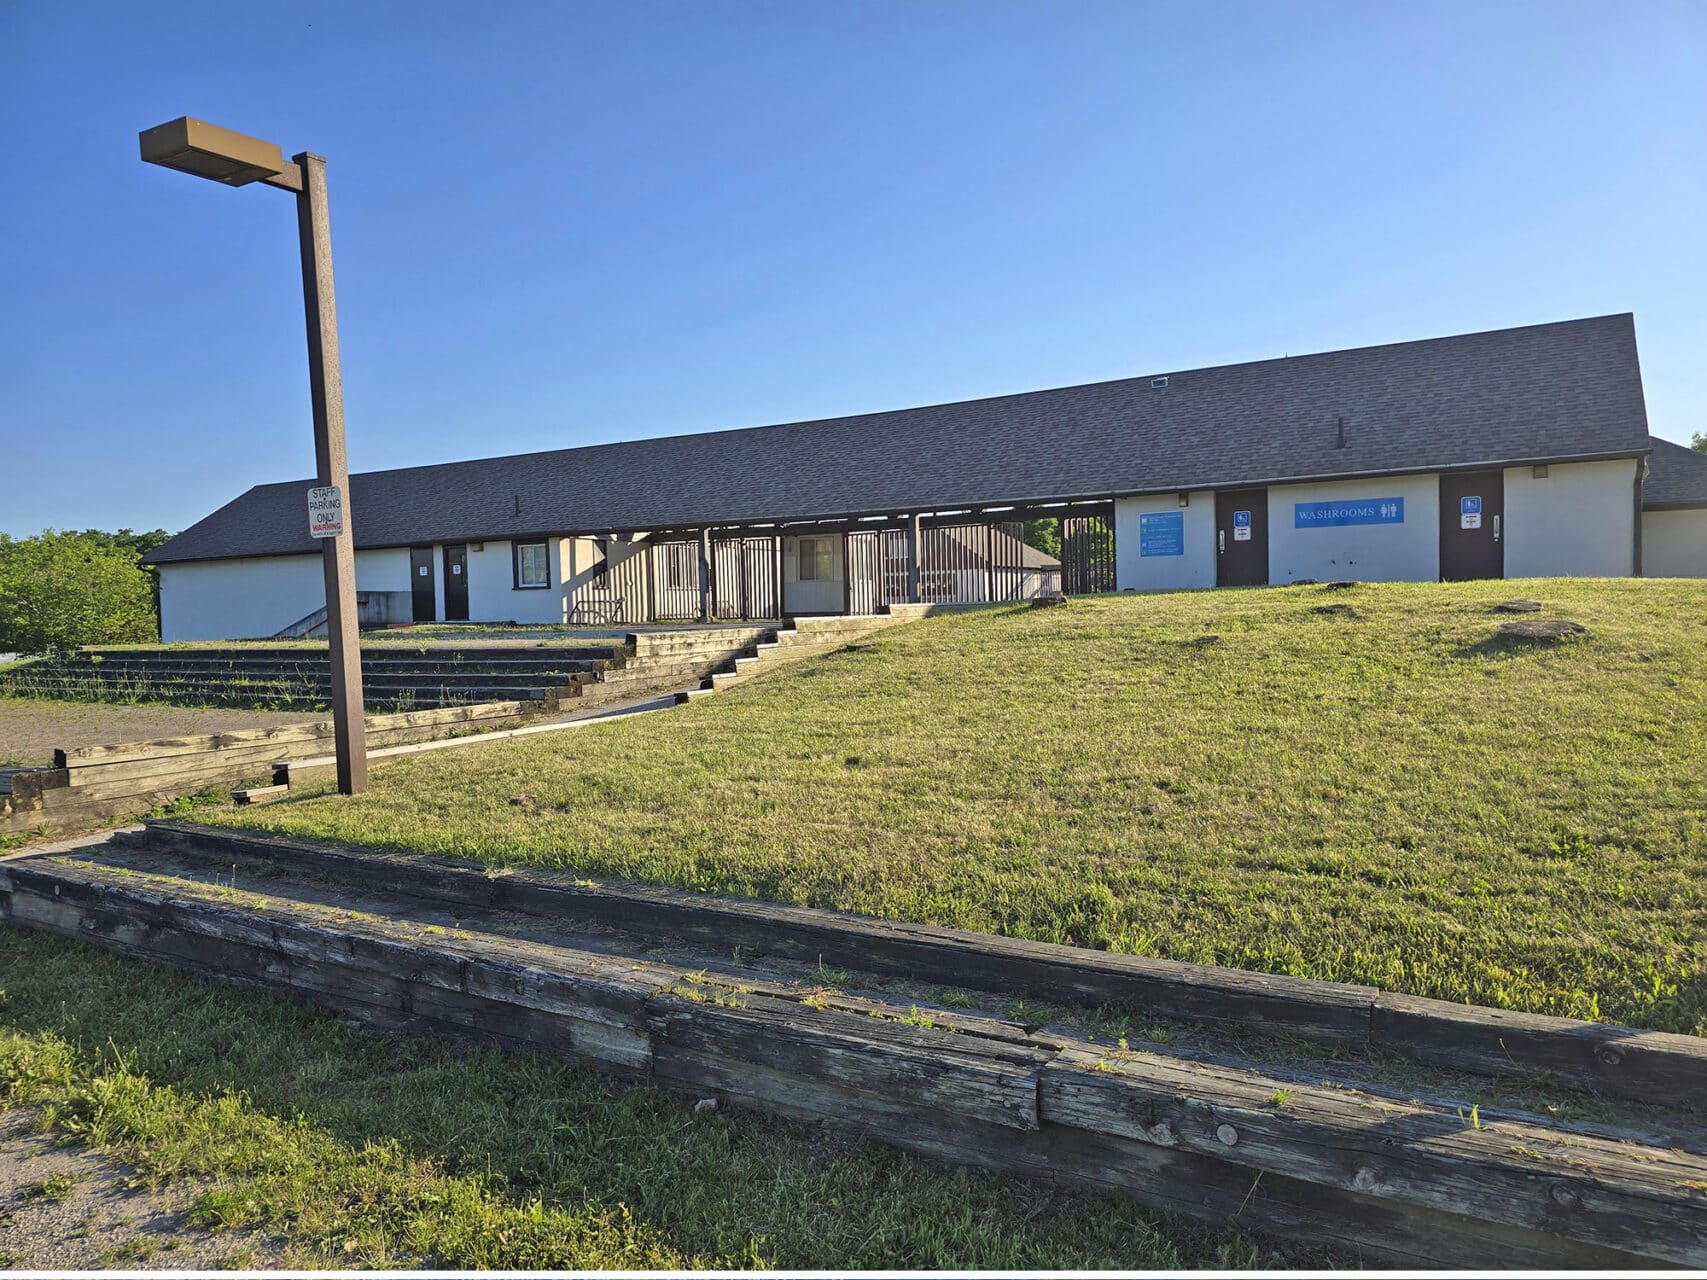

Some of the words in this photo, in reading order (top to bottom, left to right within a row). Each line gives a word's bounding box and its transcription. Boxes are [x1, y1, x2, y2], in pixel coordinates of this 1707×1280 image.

[312, 487, 336, 498] STAFF
[309, 499, 341, 511] PARKING
[317, 512, 335, 523] ONLY
[1298, 507, 1375, 520] WASHROOMS
[312, 523, 341, 531] WARNING
